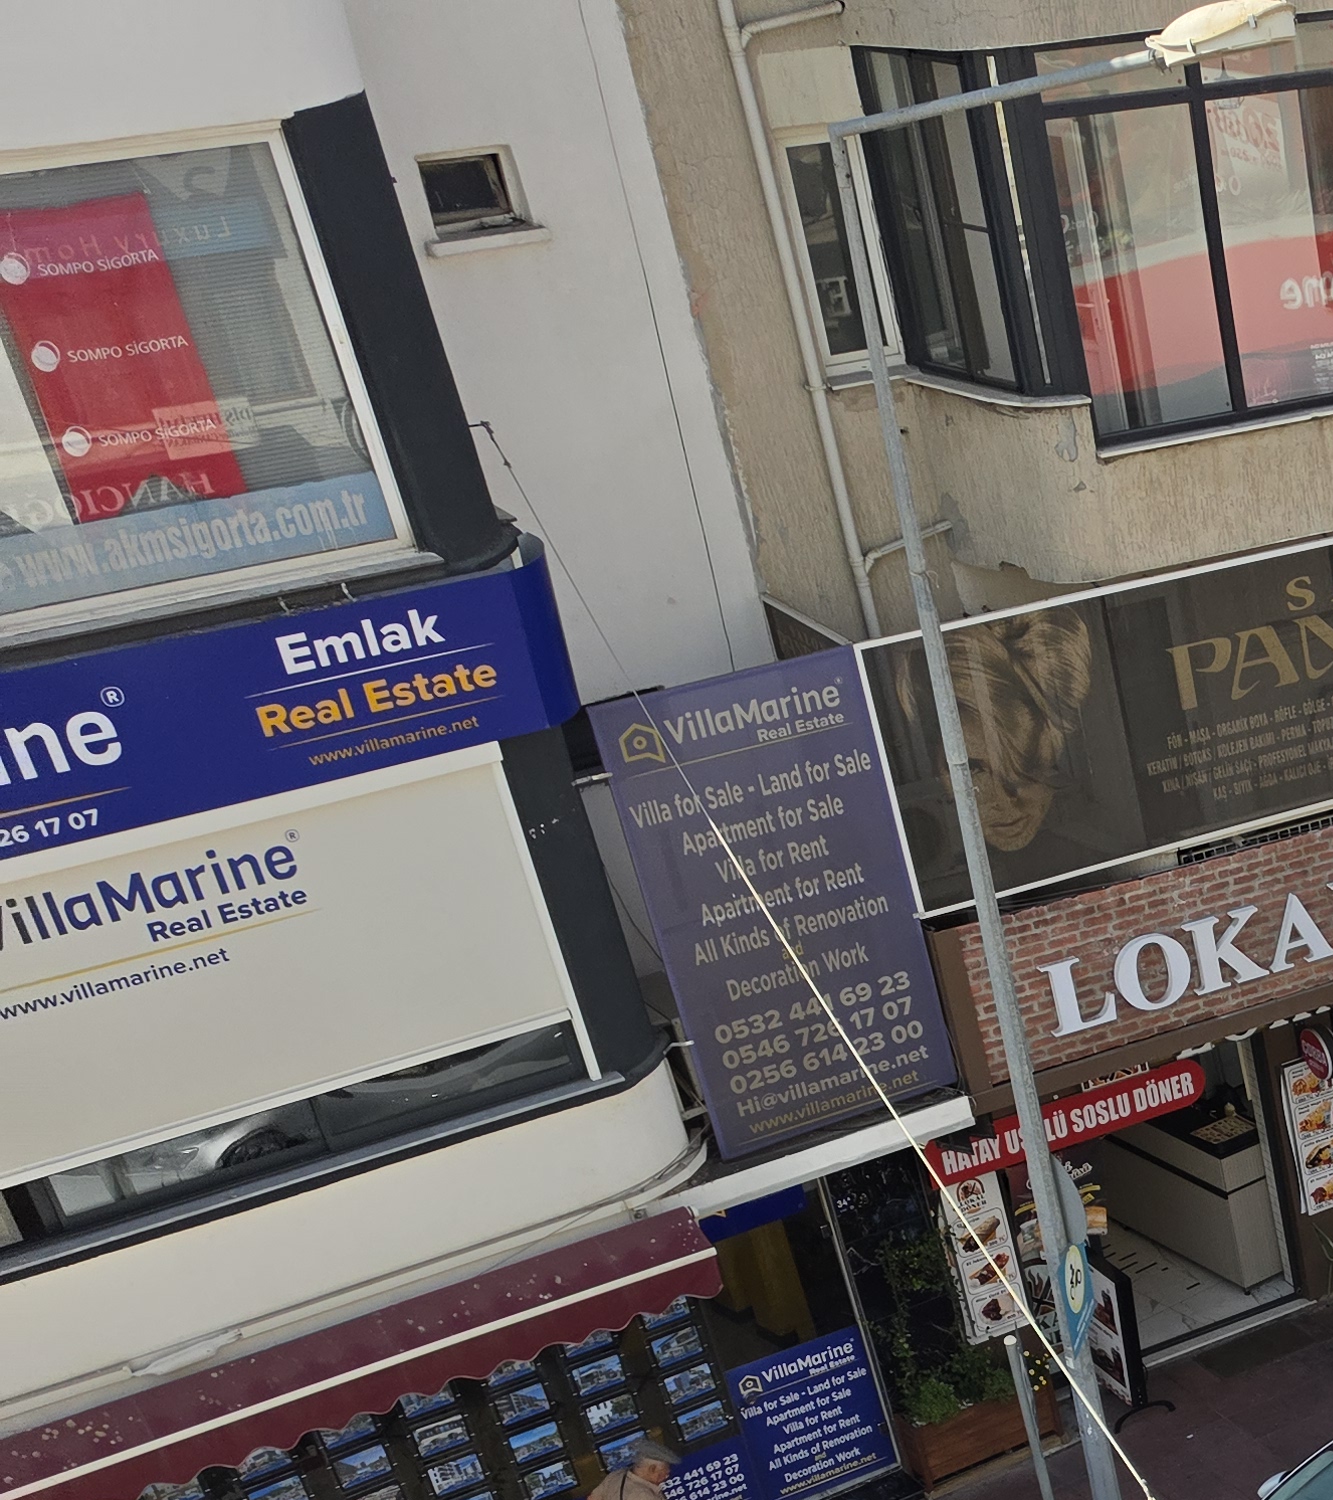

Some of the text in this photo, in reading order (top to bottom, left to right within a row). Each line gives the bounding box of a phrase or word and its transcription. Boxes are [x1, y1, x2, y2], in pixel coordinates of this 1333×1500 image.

[37, 261, 94, 278] SOMPO
[67, 335, 189, 363] SOMPO SİGORTA
[97, 430, 152, 448] SOMPO
[275, 609, 446, 675] Emlak
[255, 663, 497, 738] Real Estate
[663, 685, 840, 745] VillaMarine
[309, 716, 480, 766] www.villamarine.net
[757, 712, 844, 743] Real Estate
[629, 748, 871, 829] Villa for Sale Land for Sale
[34, 816, 62, 840] 17
[68, 807, 99, 830] 07
[682, 794, 845, 856] Apartment for Sale
[758, 849, 784, 874] for
[787, 834, 829, 865] Rent
[0, 842, 299, 950] illaMarine
[795, 876, 820, 900] for
[823, 862, 864, 892] Rent
[146, 887, 308, 942] Real Estate
[695, 942, 718, 966] All
[720, 927, 771, 958] Kinds
[794, 894, 889, 937] Renovation
[726, 942, 870, 1002] Decoration Work
[714, 1009, 783, 1045] 0532
[839, 982, 872, 1007] 69
[877, 971, 911, 996] 23
[722, 1035, 791, 1070] 0546
[850, 1007, 875, 1030] 17
[882, 996, 912, 1021] 07
[730, 1020, 924, 1095] 0256 614 23 00
[749, 1070, 920, 1134] www.villamarine.net
[1070, 1093, 1131, 1133] SOSLU
[1133, 1071, 1195, 1112] DÖNER
[761, 1342, 854, 1384] VillaMarine
[740, 1366, 867, 1420] Villa for Sale Land for Sale
[766, 1387, 852, 1427] Apartment for Sale
[773, 1414, 861, 1454] Apartment for Rent
[783, 1405, 843, 1435] Villa for Rent
[684, 1453, 738, 1481] 441 69 23
[768, 1425, 873, 1471] All Kinds of Renovation
[784, 1447, 861, 1483] Decoration Work
[686, 1464, 739, 1491] 726 17 07
[689, 1487, 710, 1500] 614
[712, 1480, 727, 1492] 23
[729, 1474, 745, 1485] 00
[780, 1452, 877, 1495] www.villamarine.net
